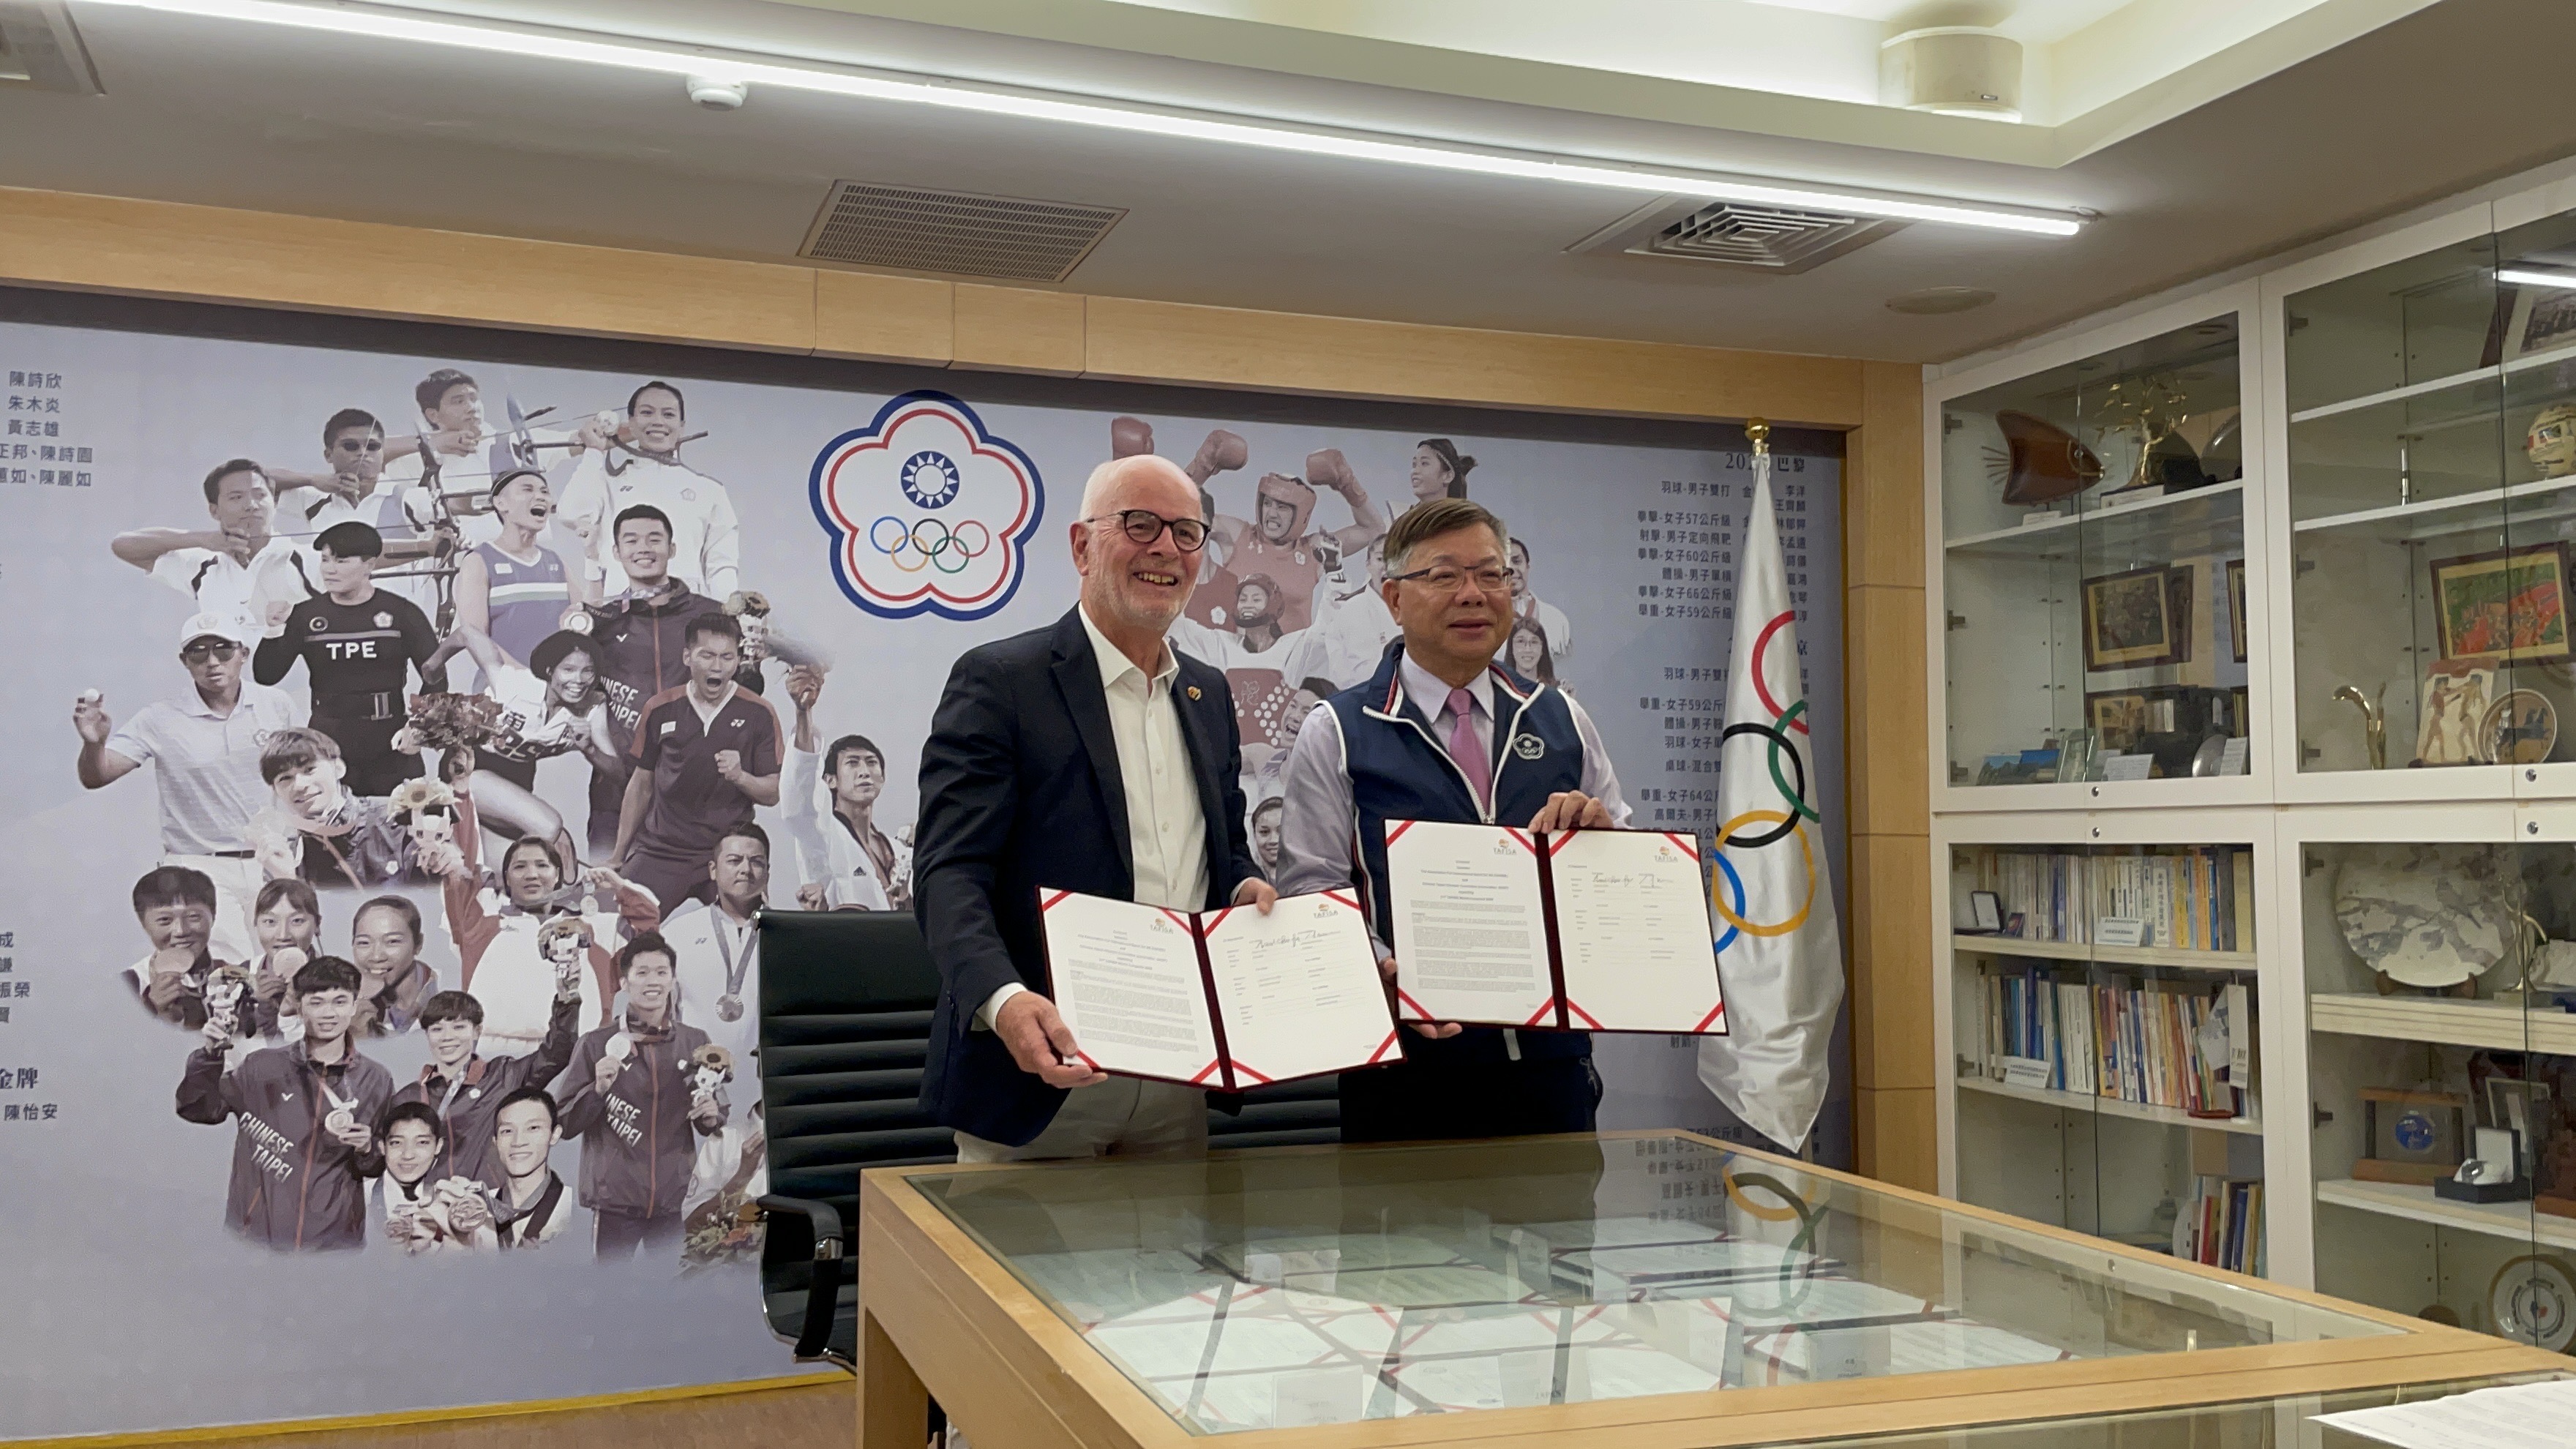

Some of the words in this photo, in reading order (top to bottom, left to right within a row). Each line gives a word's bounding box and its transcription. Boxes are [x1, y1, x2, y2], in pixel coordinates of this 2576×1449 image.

[10, 370, 61, 389] 陳詩欣
[8, 395, 60, 413] 朱木炎
[7, 419, 59, 437] 黃志雄
[326, 641, 378, 660] TPE
[4, 1104, 58, 1121] 陳怡安
[239, 1112, 294, 1158] CHINESE
[251, 1144, 293, 1183] TAIPEI
